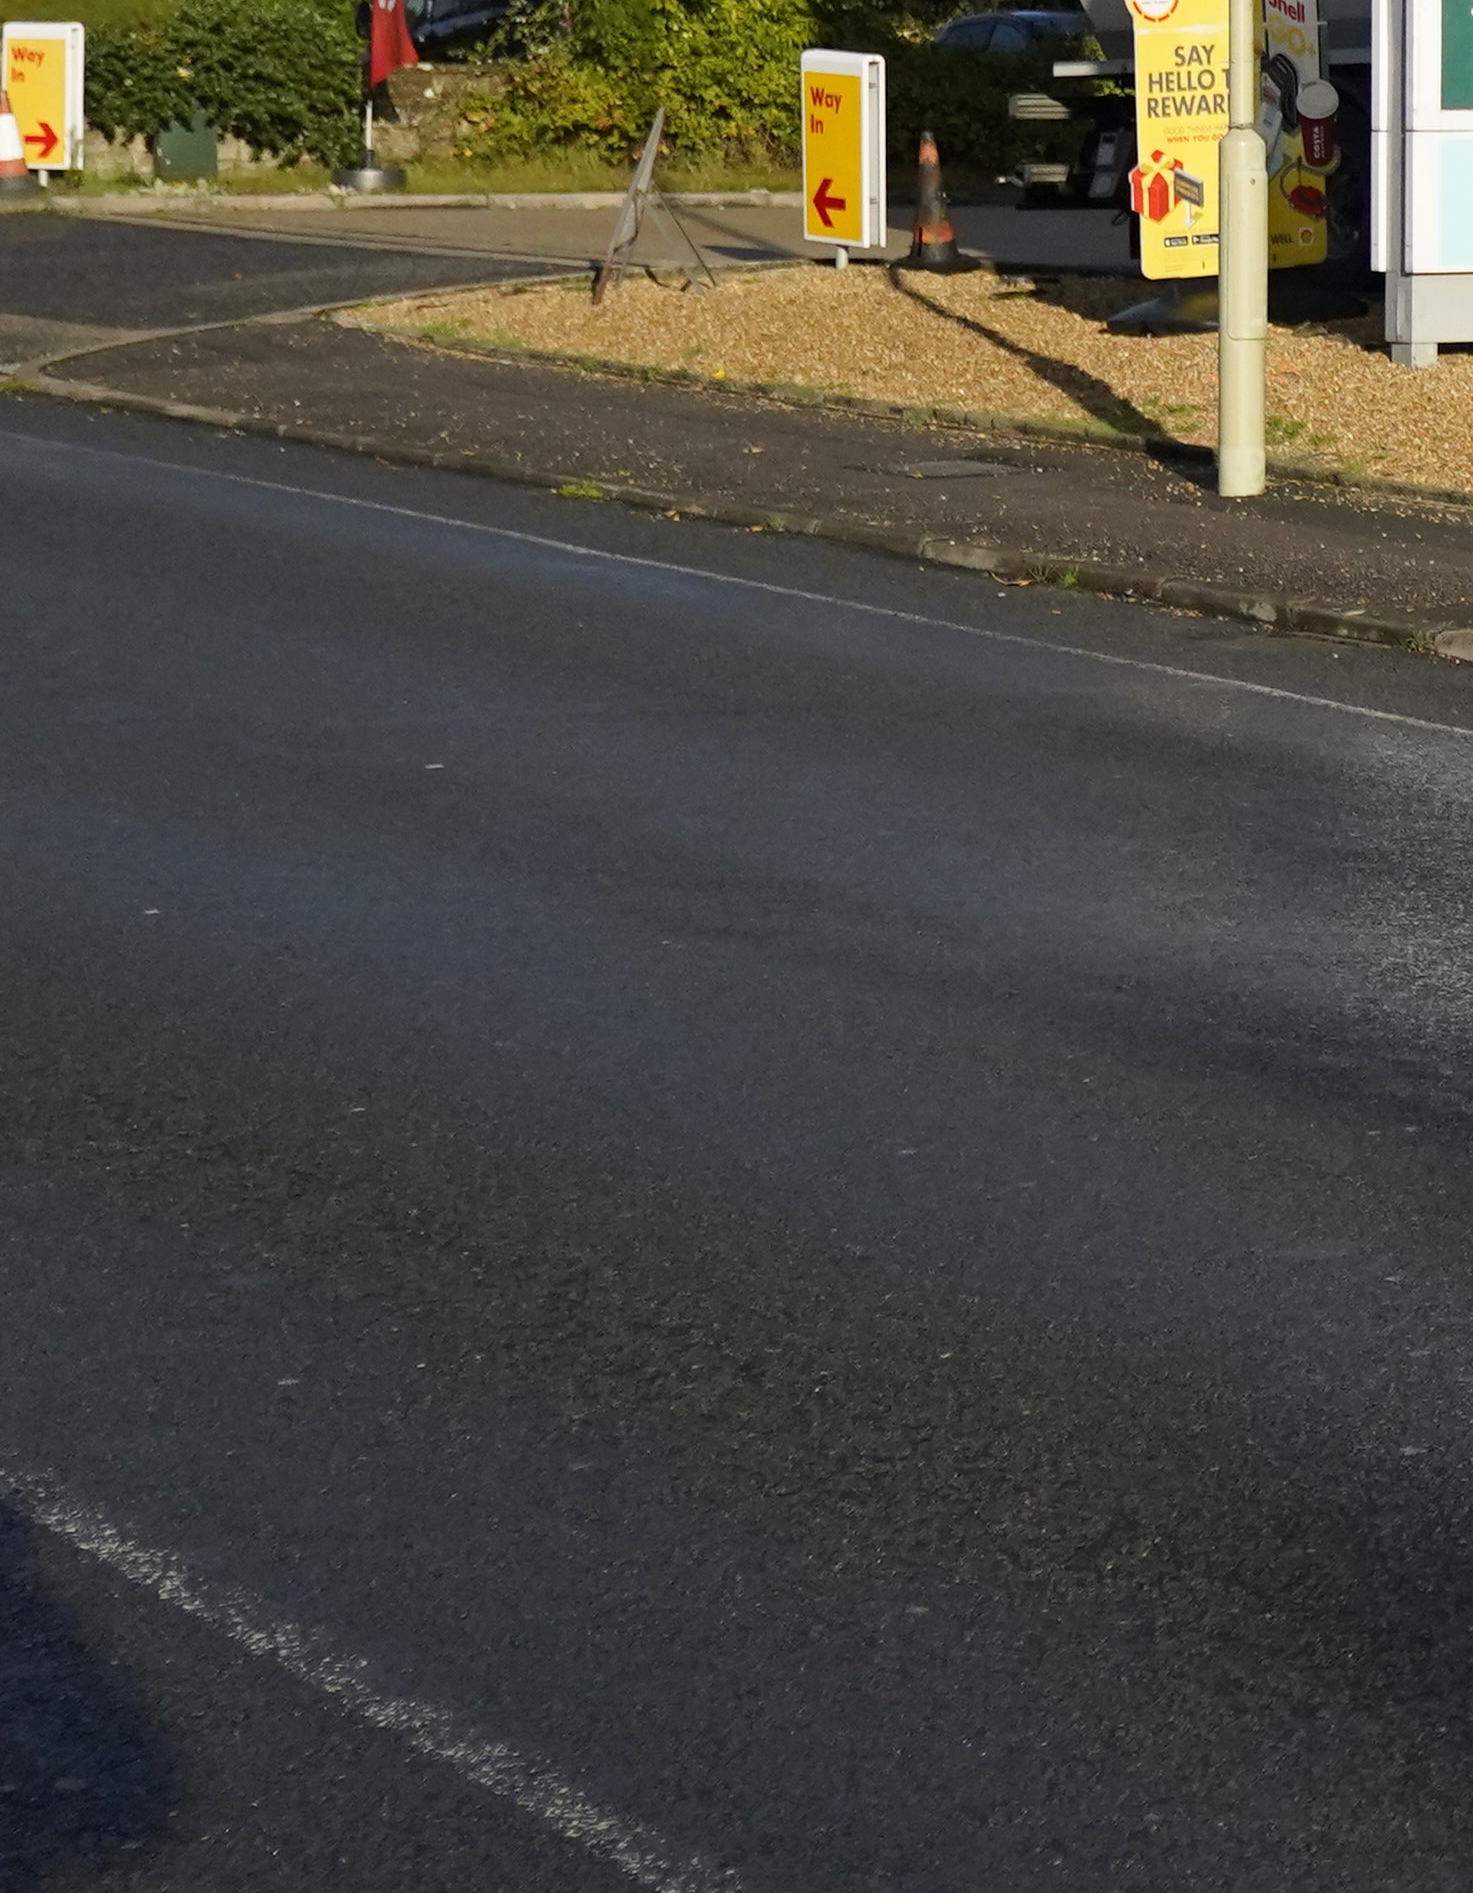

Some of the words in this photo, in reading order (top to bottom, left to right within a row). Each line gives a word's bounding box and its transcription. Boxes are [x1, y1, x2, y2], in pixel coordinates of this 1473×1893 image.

[11, 47, 46, 67] Way
[1174, 44, 1215, 67] SAY
[1147, 69, 1216, 94] HELLO
[810, 86, 842, 115] Way
[1147, 93, 1230, 119] REWAR
[810, 113, 824, 135] In
